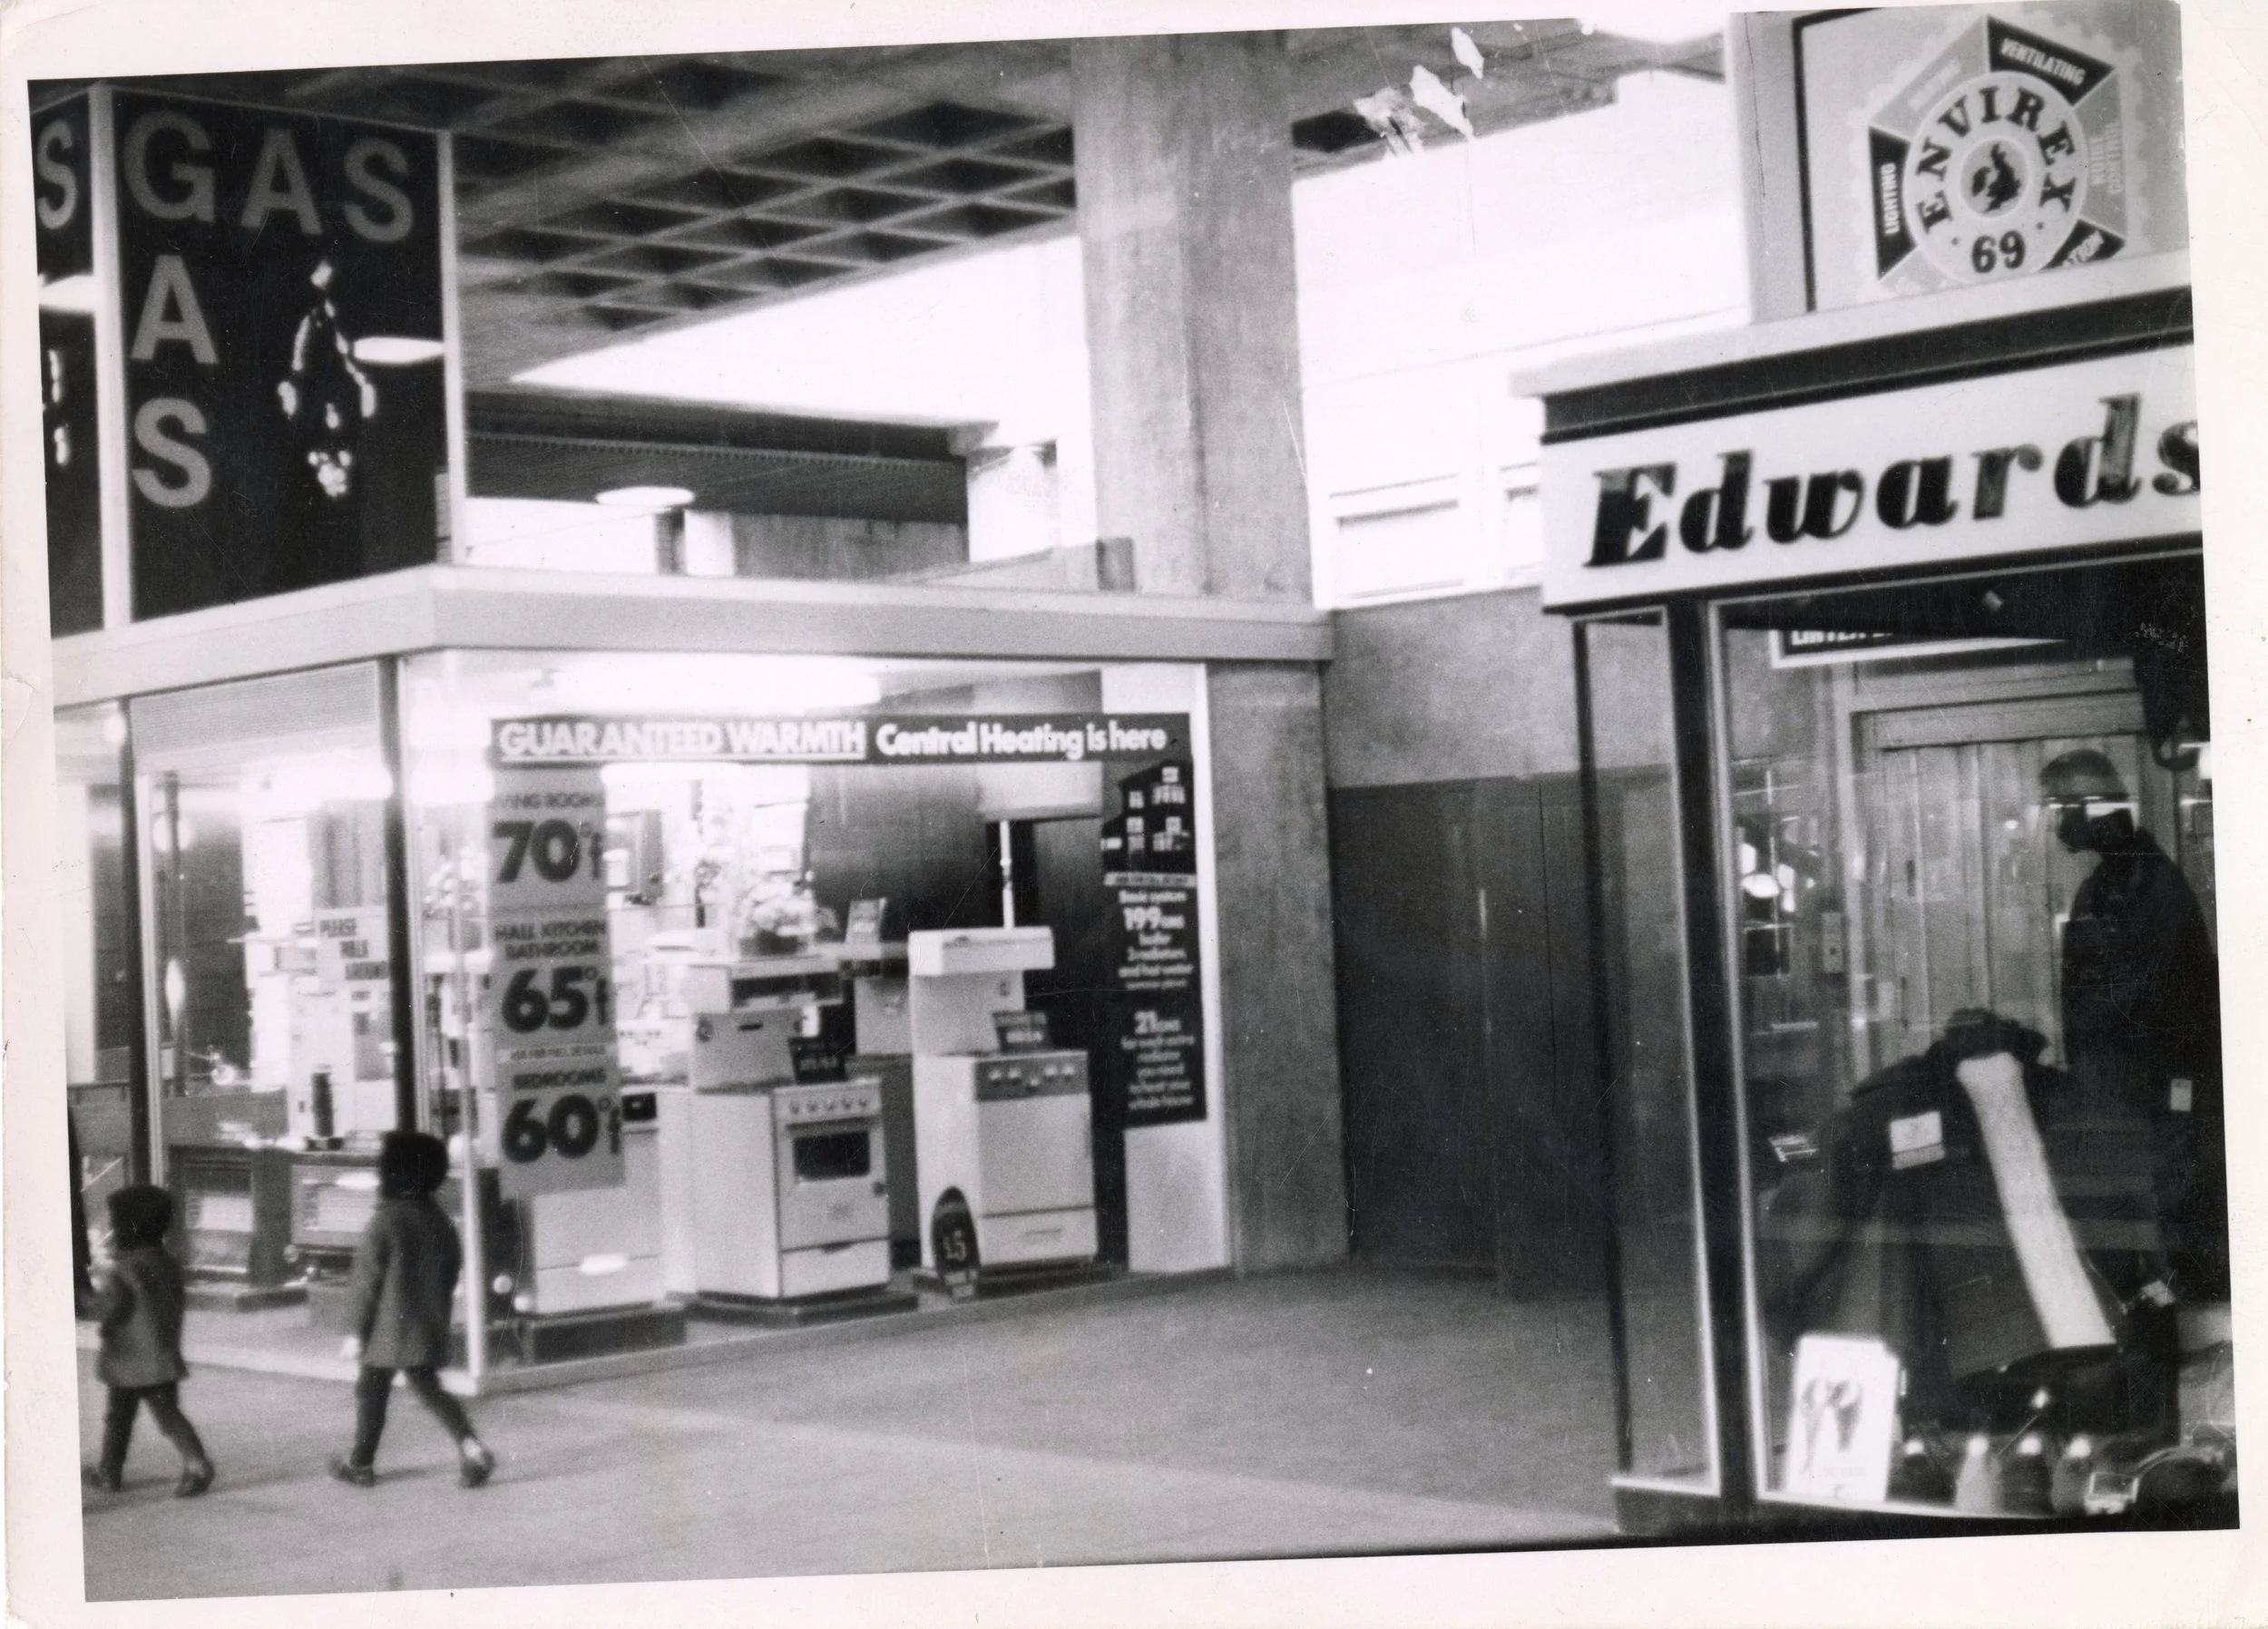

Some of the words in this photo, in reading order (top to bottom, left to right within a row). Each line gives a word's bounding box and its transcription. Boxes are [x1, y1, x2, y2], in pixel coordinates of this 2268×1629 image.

[1999, 37, 2087, 86] VENTILATING
[123, 110, 415, 243] GAS
[1915, 85, 2077, 234] ENVIREX
[1880, 161, 1901, 235] LIGHTING
[1970, 229, 2027, 273] 69
[1581, 392, 2201, 570] Edwards
[499, 721, 722, 756] GUARANTEED
[728, 720, 865, 755] WARMTH
[875, 721, 978, 756] Central
[980, 722, 1087, 761] Heating
[1087, 722, 1108, 752] is
[1109, 719, 1168, 751] here
